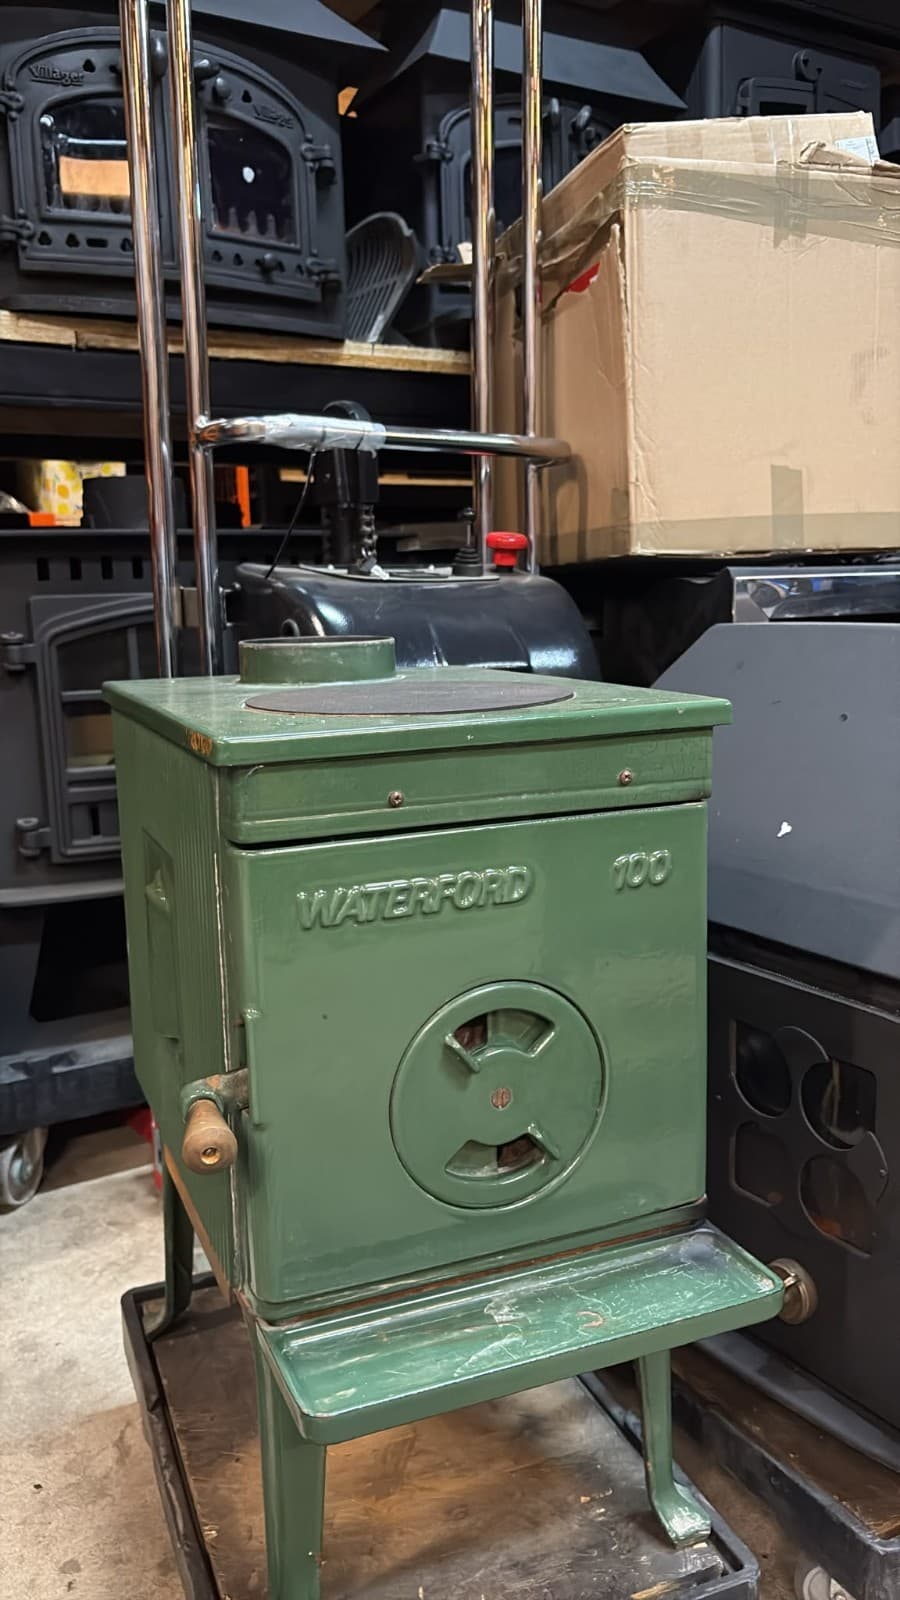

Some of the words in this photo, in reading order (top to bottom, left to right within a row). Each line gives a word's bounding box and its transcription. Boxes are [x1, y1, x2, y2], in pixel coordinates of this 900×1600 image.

[29, 63, 84, 87] Villager
[297, 866, 534, 930] WATERFORD
[612, 849, 671, 891] 100
